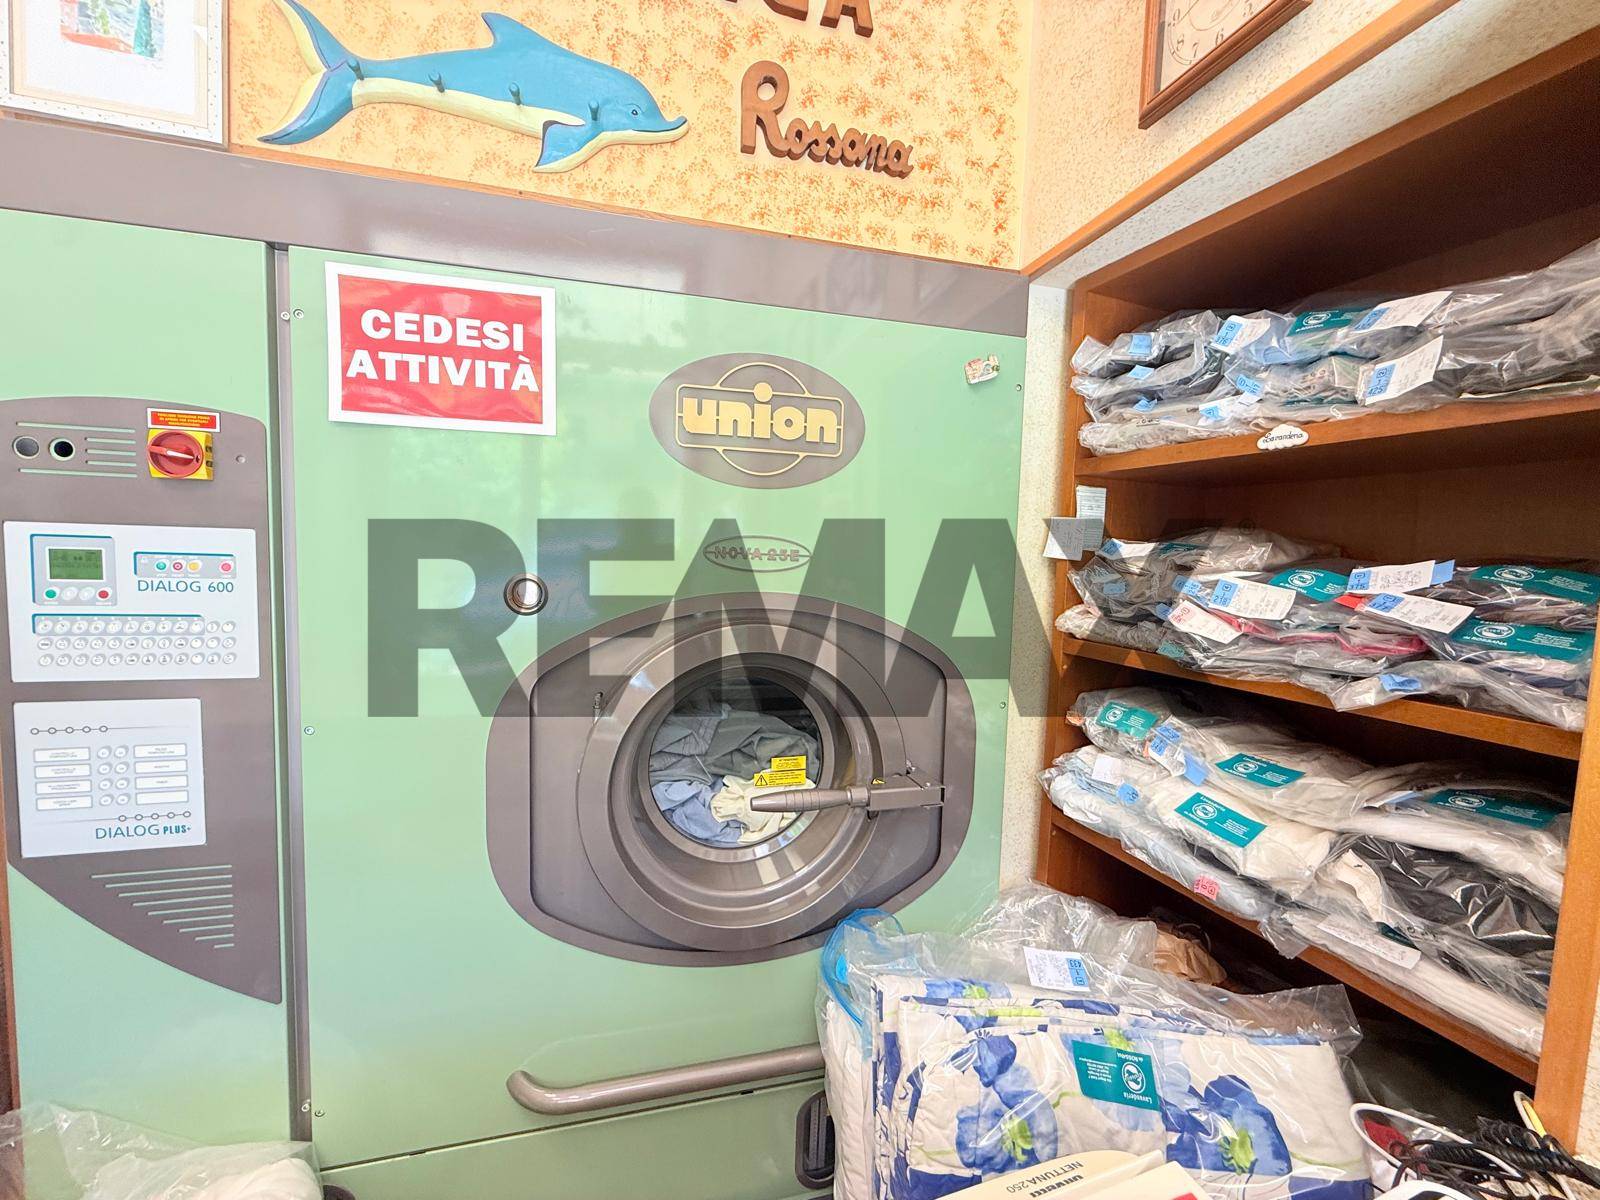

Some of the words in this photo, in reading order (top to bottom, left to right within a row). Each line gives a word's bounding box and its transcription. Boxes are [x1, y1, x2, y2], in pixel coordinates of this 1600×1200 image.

[360, 308, 525, 353] CEDESI
[345, 348, 540, 393] ATTIVITÀ
[682, 381, 839, 445] union
[713, 544, 763, 562] NOVA
[137, 579, 202, 593] DIALOG
[207, 581, 234, 593] 600
[95, 824, 160, 840] DIALOG
[1025, 1161, 1084, 1185] NETTUNA
[1006, 1180, 1029, 1194] 250
